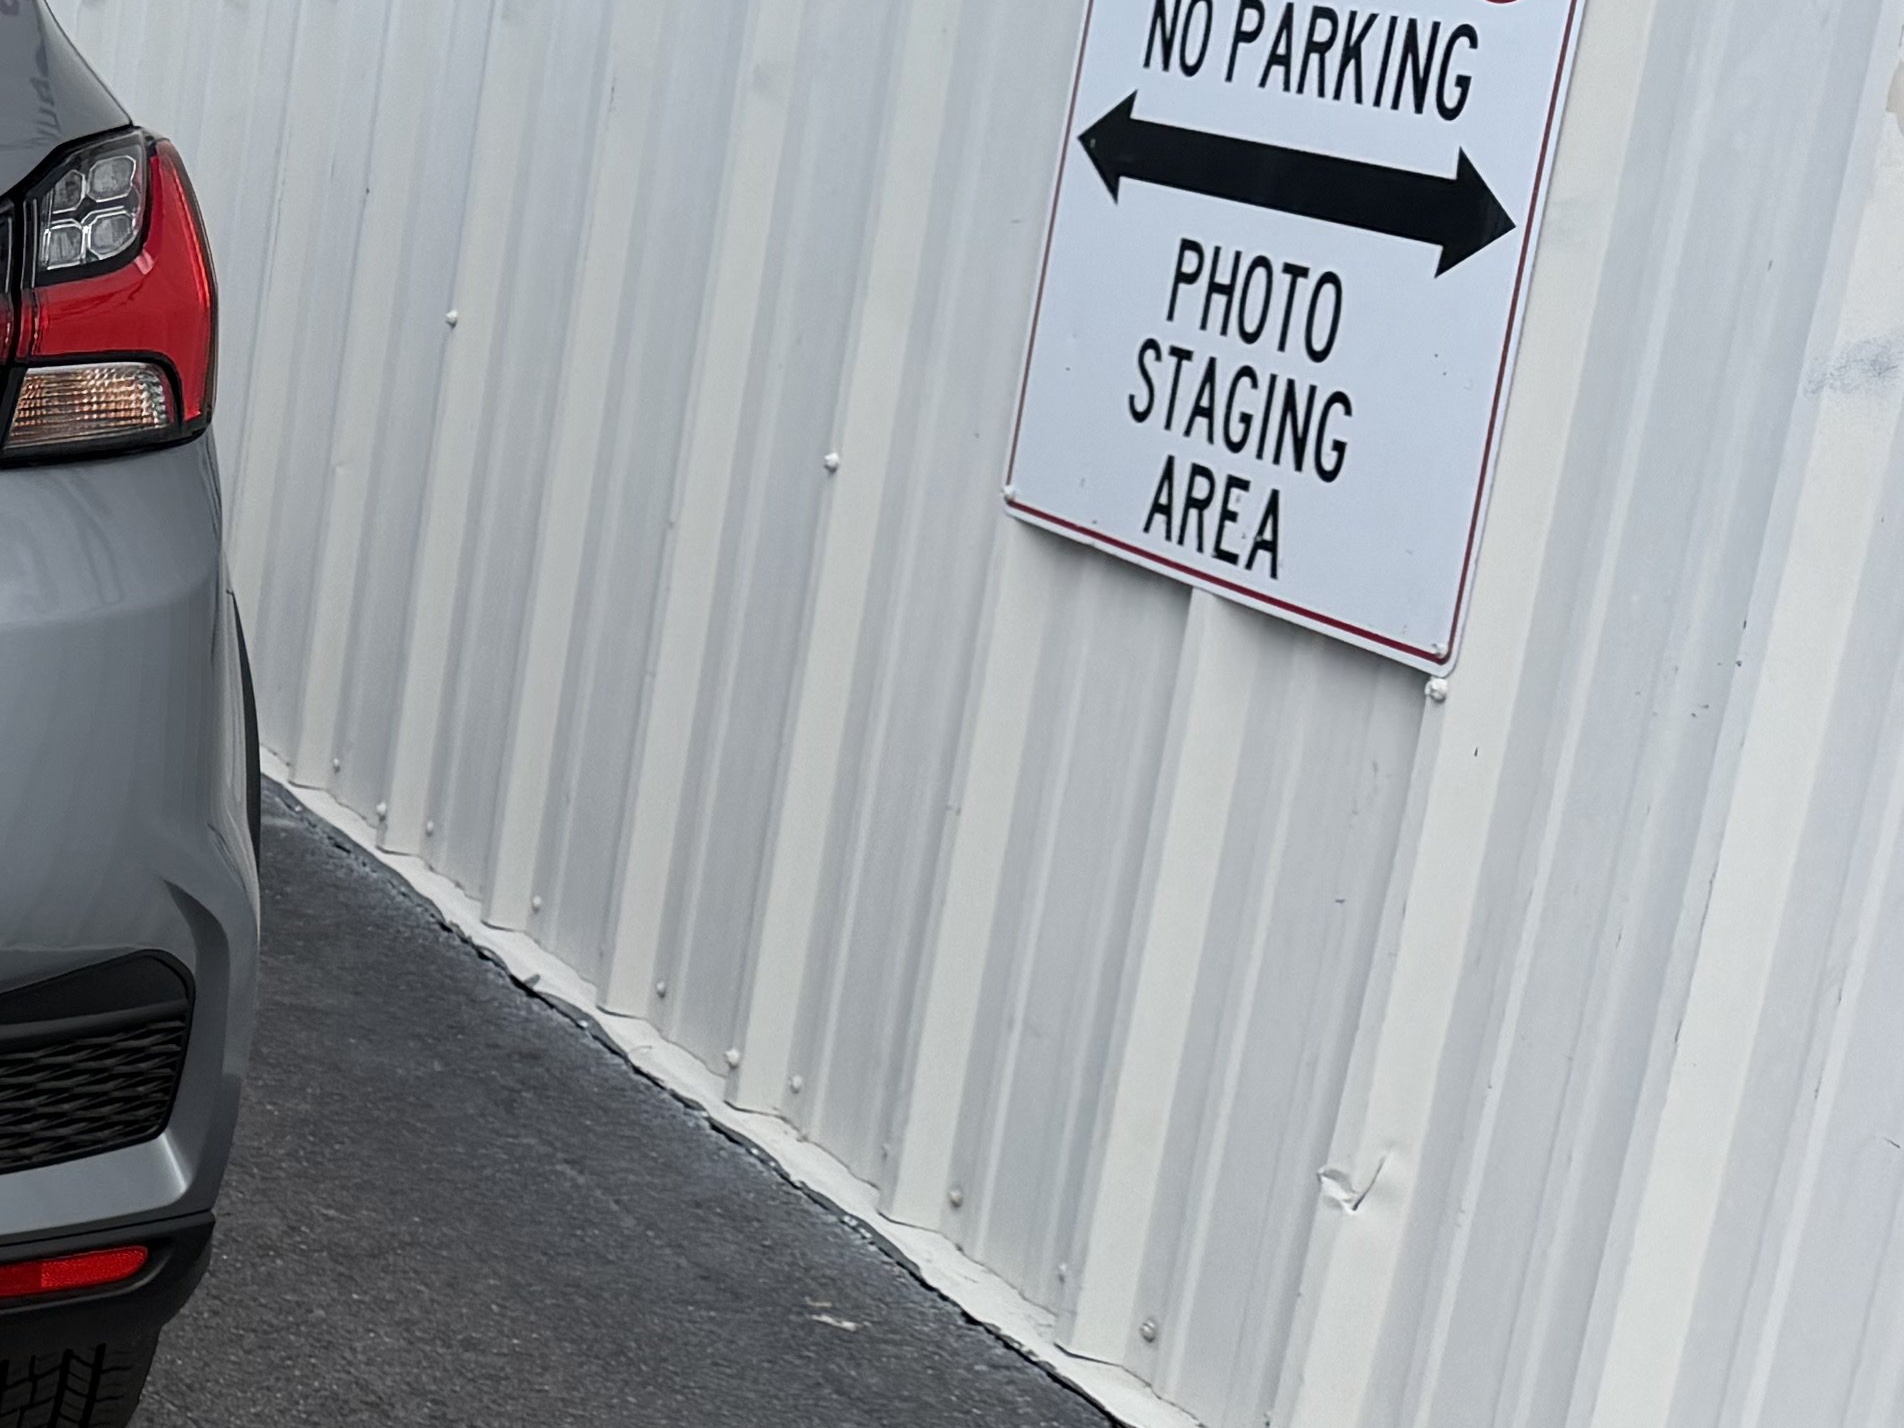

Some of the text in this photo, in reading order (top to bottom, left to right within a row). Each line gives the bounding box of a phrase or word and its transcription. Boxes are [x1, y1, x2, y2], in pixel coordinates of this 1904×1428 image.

[1165, 236, 1344, 365] PHOTO
[1127, 337, 1354, 484] STAGING
[1141, 453, 1281, 581] AREA
